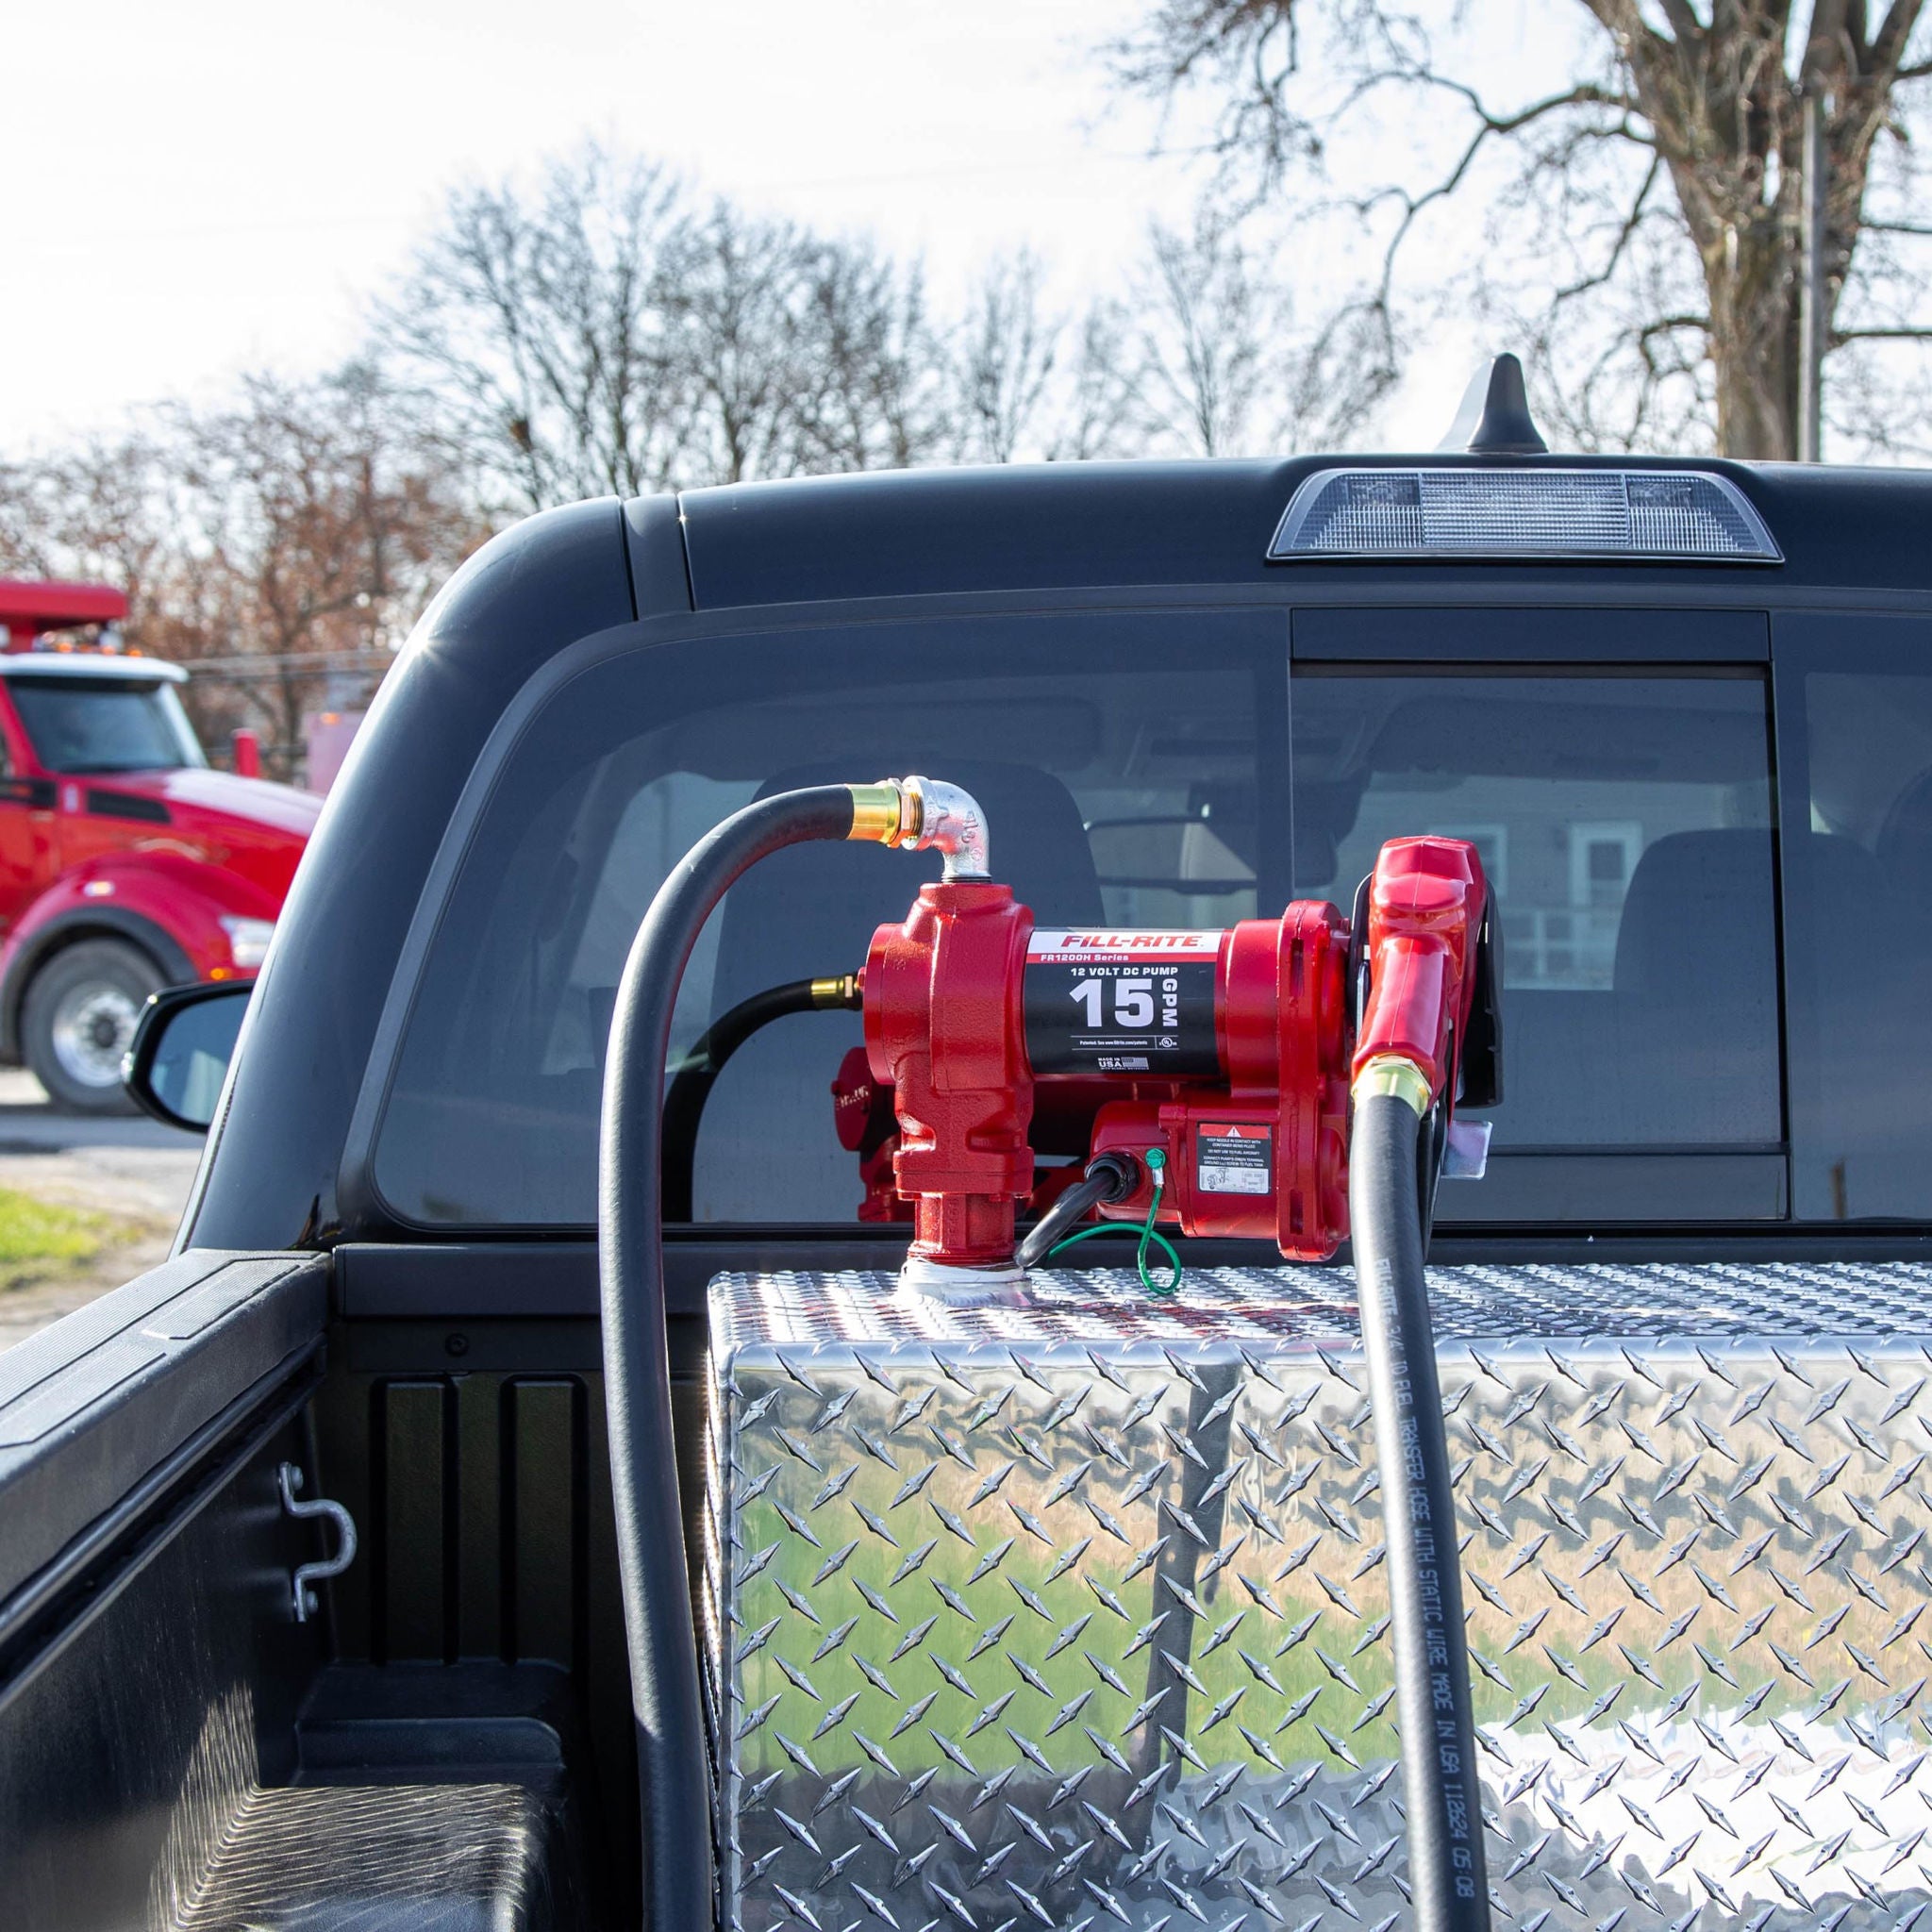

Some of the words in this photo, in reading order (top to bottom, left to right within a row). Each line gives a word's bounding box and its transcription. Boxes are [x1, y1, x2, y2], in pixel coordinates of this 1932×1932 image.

[1061, 935, 1203, 948] FILL-RITE
[1071, 967, 1086, 976] 12
[1090, 967, 1119, 976] VOLT
[1123, 967, 1140, 975] DC
[1142, 967, 1178, 975] PUMP
[1070, 978, 1155, 1028] 15
[1162, 978, 1178, 1027] GPM
[1390, 1360, 1407, 1375] ID
[1392, 1378, 1413, 1407] FUEL
[1399, 1416, 1425, 1482] TRANSFER
[1408, 1487, 1431, 1522] HOSE
[1414, 1527, 1436, 1562] WITH
[1418, 1569, 1443, 1623] STATIC
[1425, 1628, 1448, 1665] WIRE
[1431, 1673, 1454, 1711] MADE
[1437, 1720, 1457, 1738] IN
[1440, 1744, 1459, 1774] USA
[1444, 1783, 1469, 1839] 112624
